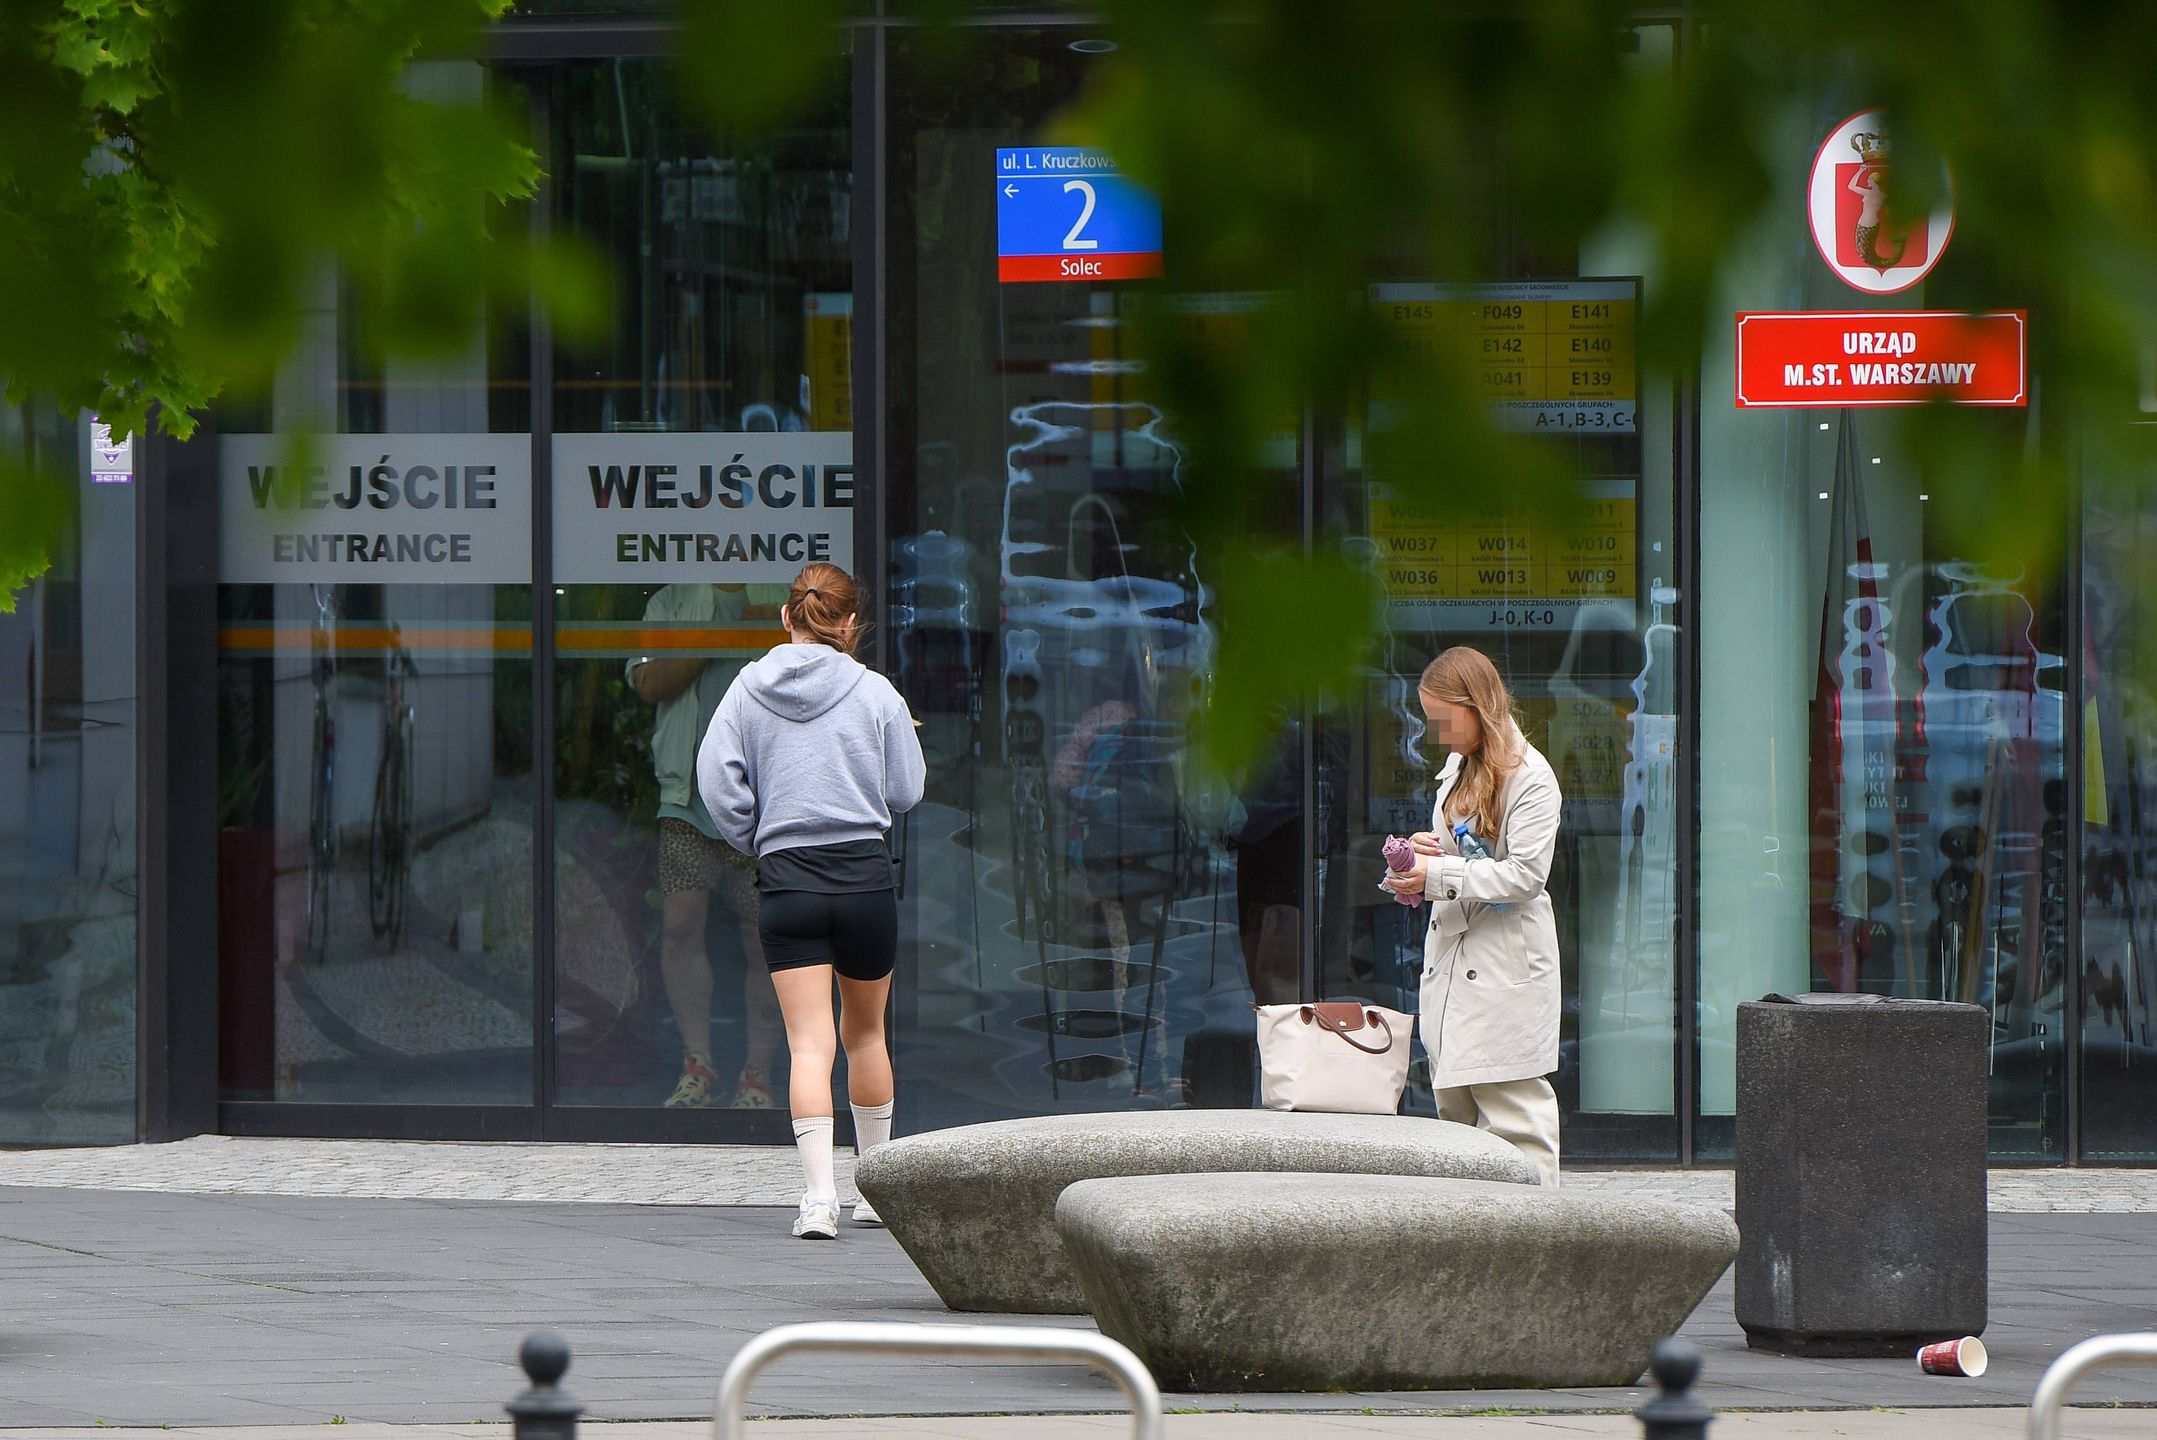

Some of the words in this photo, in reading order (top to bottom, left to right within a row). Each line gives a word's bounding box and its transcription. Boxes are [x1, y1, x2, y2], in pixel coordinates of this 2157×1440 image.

[1002, 153, 1021, 170] ul.
[1025, 153, 1037, 169] L.
[1062, 179, 1098, 250] 2
[1060, 257, 1103, 276] Solec
[1393, 305, 1433, 320] E145
[1483, 304, 1522, 320] F049
[1571, 304, 1610, 319] E141
[1482, 338, 1522, 353] E142
[1571, 337, 1611, 352] E140
[1843, 332, 1917, 358] URZĄD
[1481, 371, 1522, 386] A041
[1571, 371, 1611, 386] E139
[1784, 364, 1842, 387] M.ST.
[1850, 363, 1977, 386] WARSZAWY
[247, 454, 497, 510] WEJŚCIE
[588, 453, 854, 509] WEJŚCIE
[273, 533, 472, 563] ENTRANCE
[616, 533, 831, 562] ENTRANCE
[1388, 537, 1438, 552] W037
[1478, 536, 1527, 551] W014
[1567, 536, 1616, 551] W010
[1388, 569, 1438, 584] W036
[1478, 569, 1527, 584] W013
[1567, 569, 1616, 584] W009
[1497, 599, 1506, 607] W
